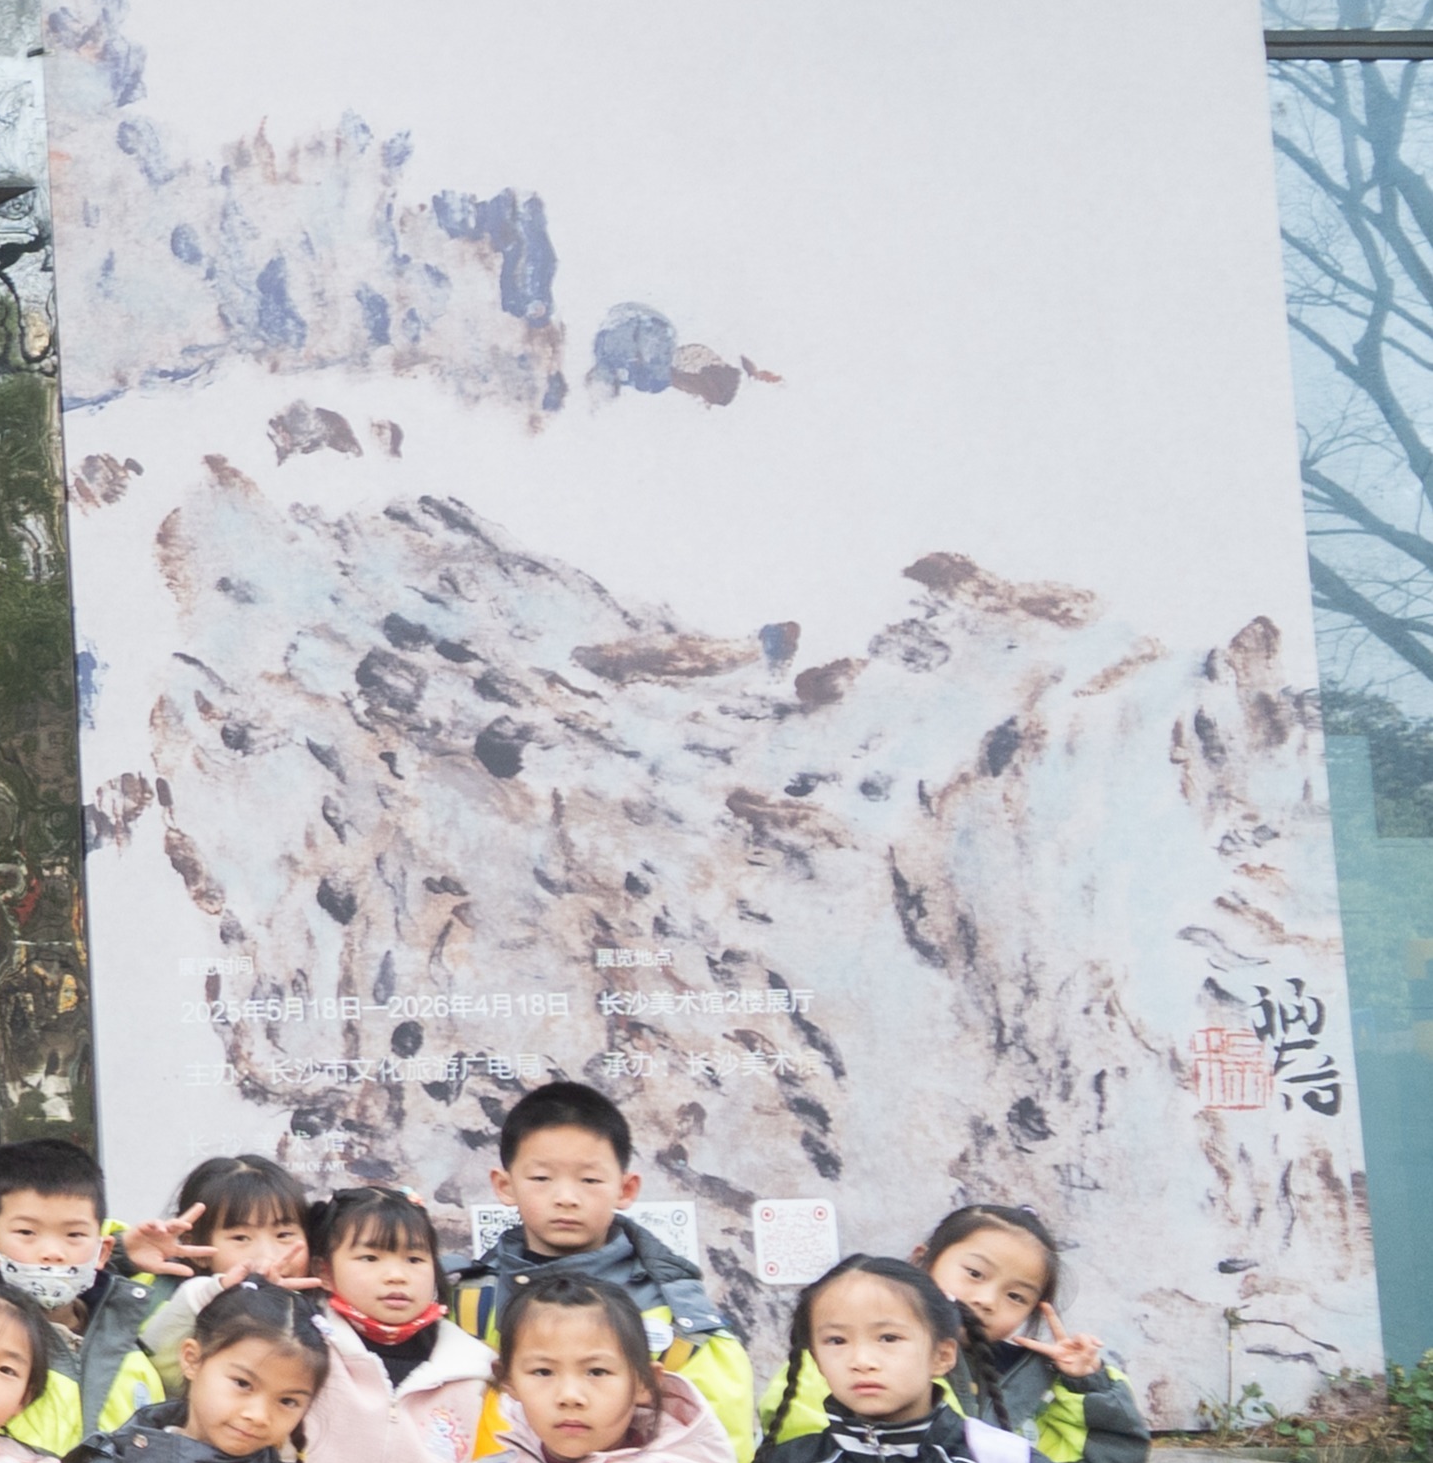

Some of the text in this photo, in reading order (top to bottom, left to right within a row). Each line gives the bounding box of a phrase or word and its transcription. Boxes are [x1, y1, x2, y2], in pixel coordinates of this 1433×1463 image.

[595, 948, 673, 968] 展览地点
[598, 988, 815, 1016] 长沙美术馆2楼展厅
